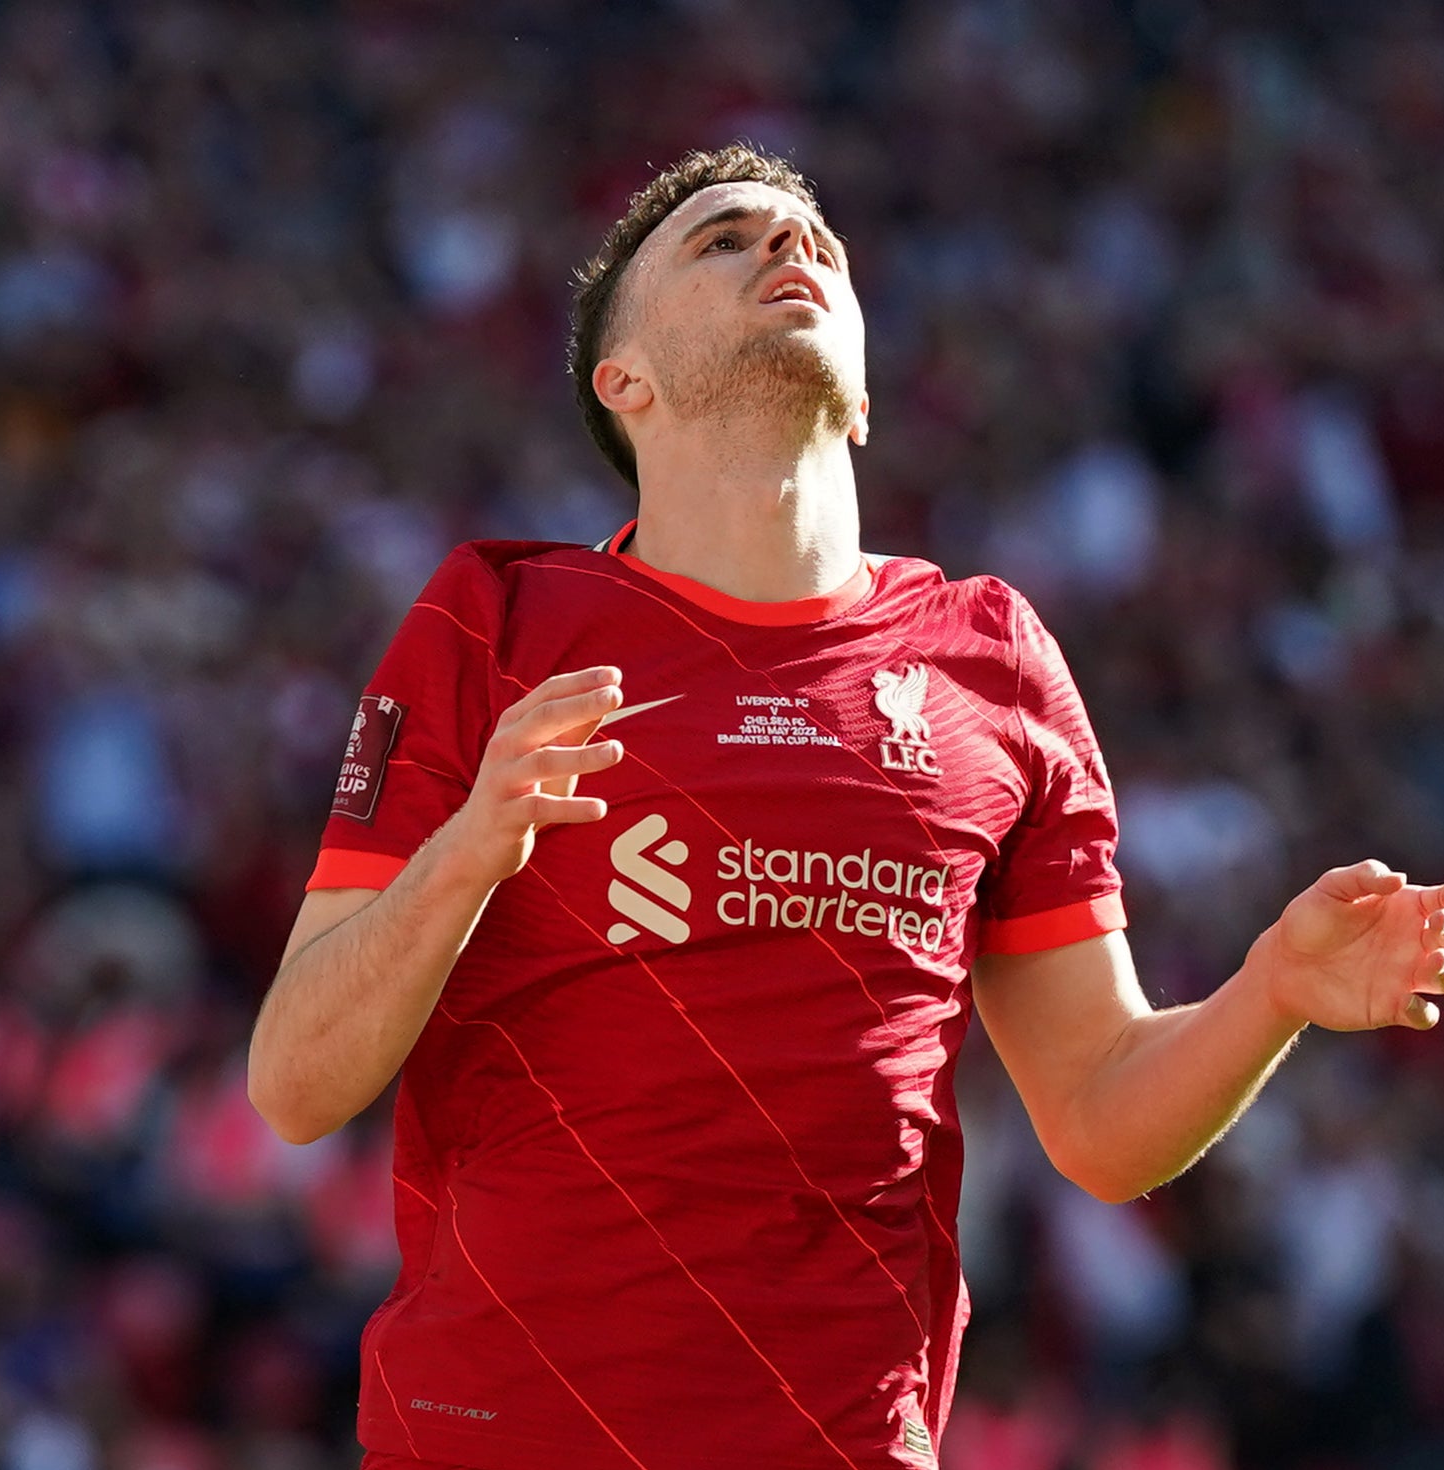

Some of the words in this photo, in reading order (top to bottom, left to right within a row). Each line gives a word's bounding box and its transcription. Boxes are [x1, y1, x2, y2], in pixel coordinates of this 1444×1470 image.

[736, 695, 793, 707] LIVERPOOL
[795, 698, 809, 707] FC
[744, 715, 791, 726] CHELSEA
[792, 717, 806, 727] FC
[739, 725, 765, 735] 14TH
[767, 726, 789, 736] MAY
[791, 727, 817, 736] 2022
[717, 734, 770, 744] EMIRATES
[772, 736, 786, 745] FA
[787, 736, 809, 746] CUP
[810, 737, 842, 747] FINAL
[717, 838, 950, 906] standard
[716, 883, 951, 953] chartered
